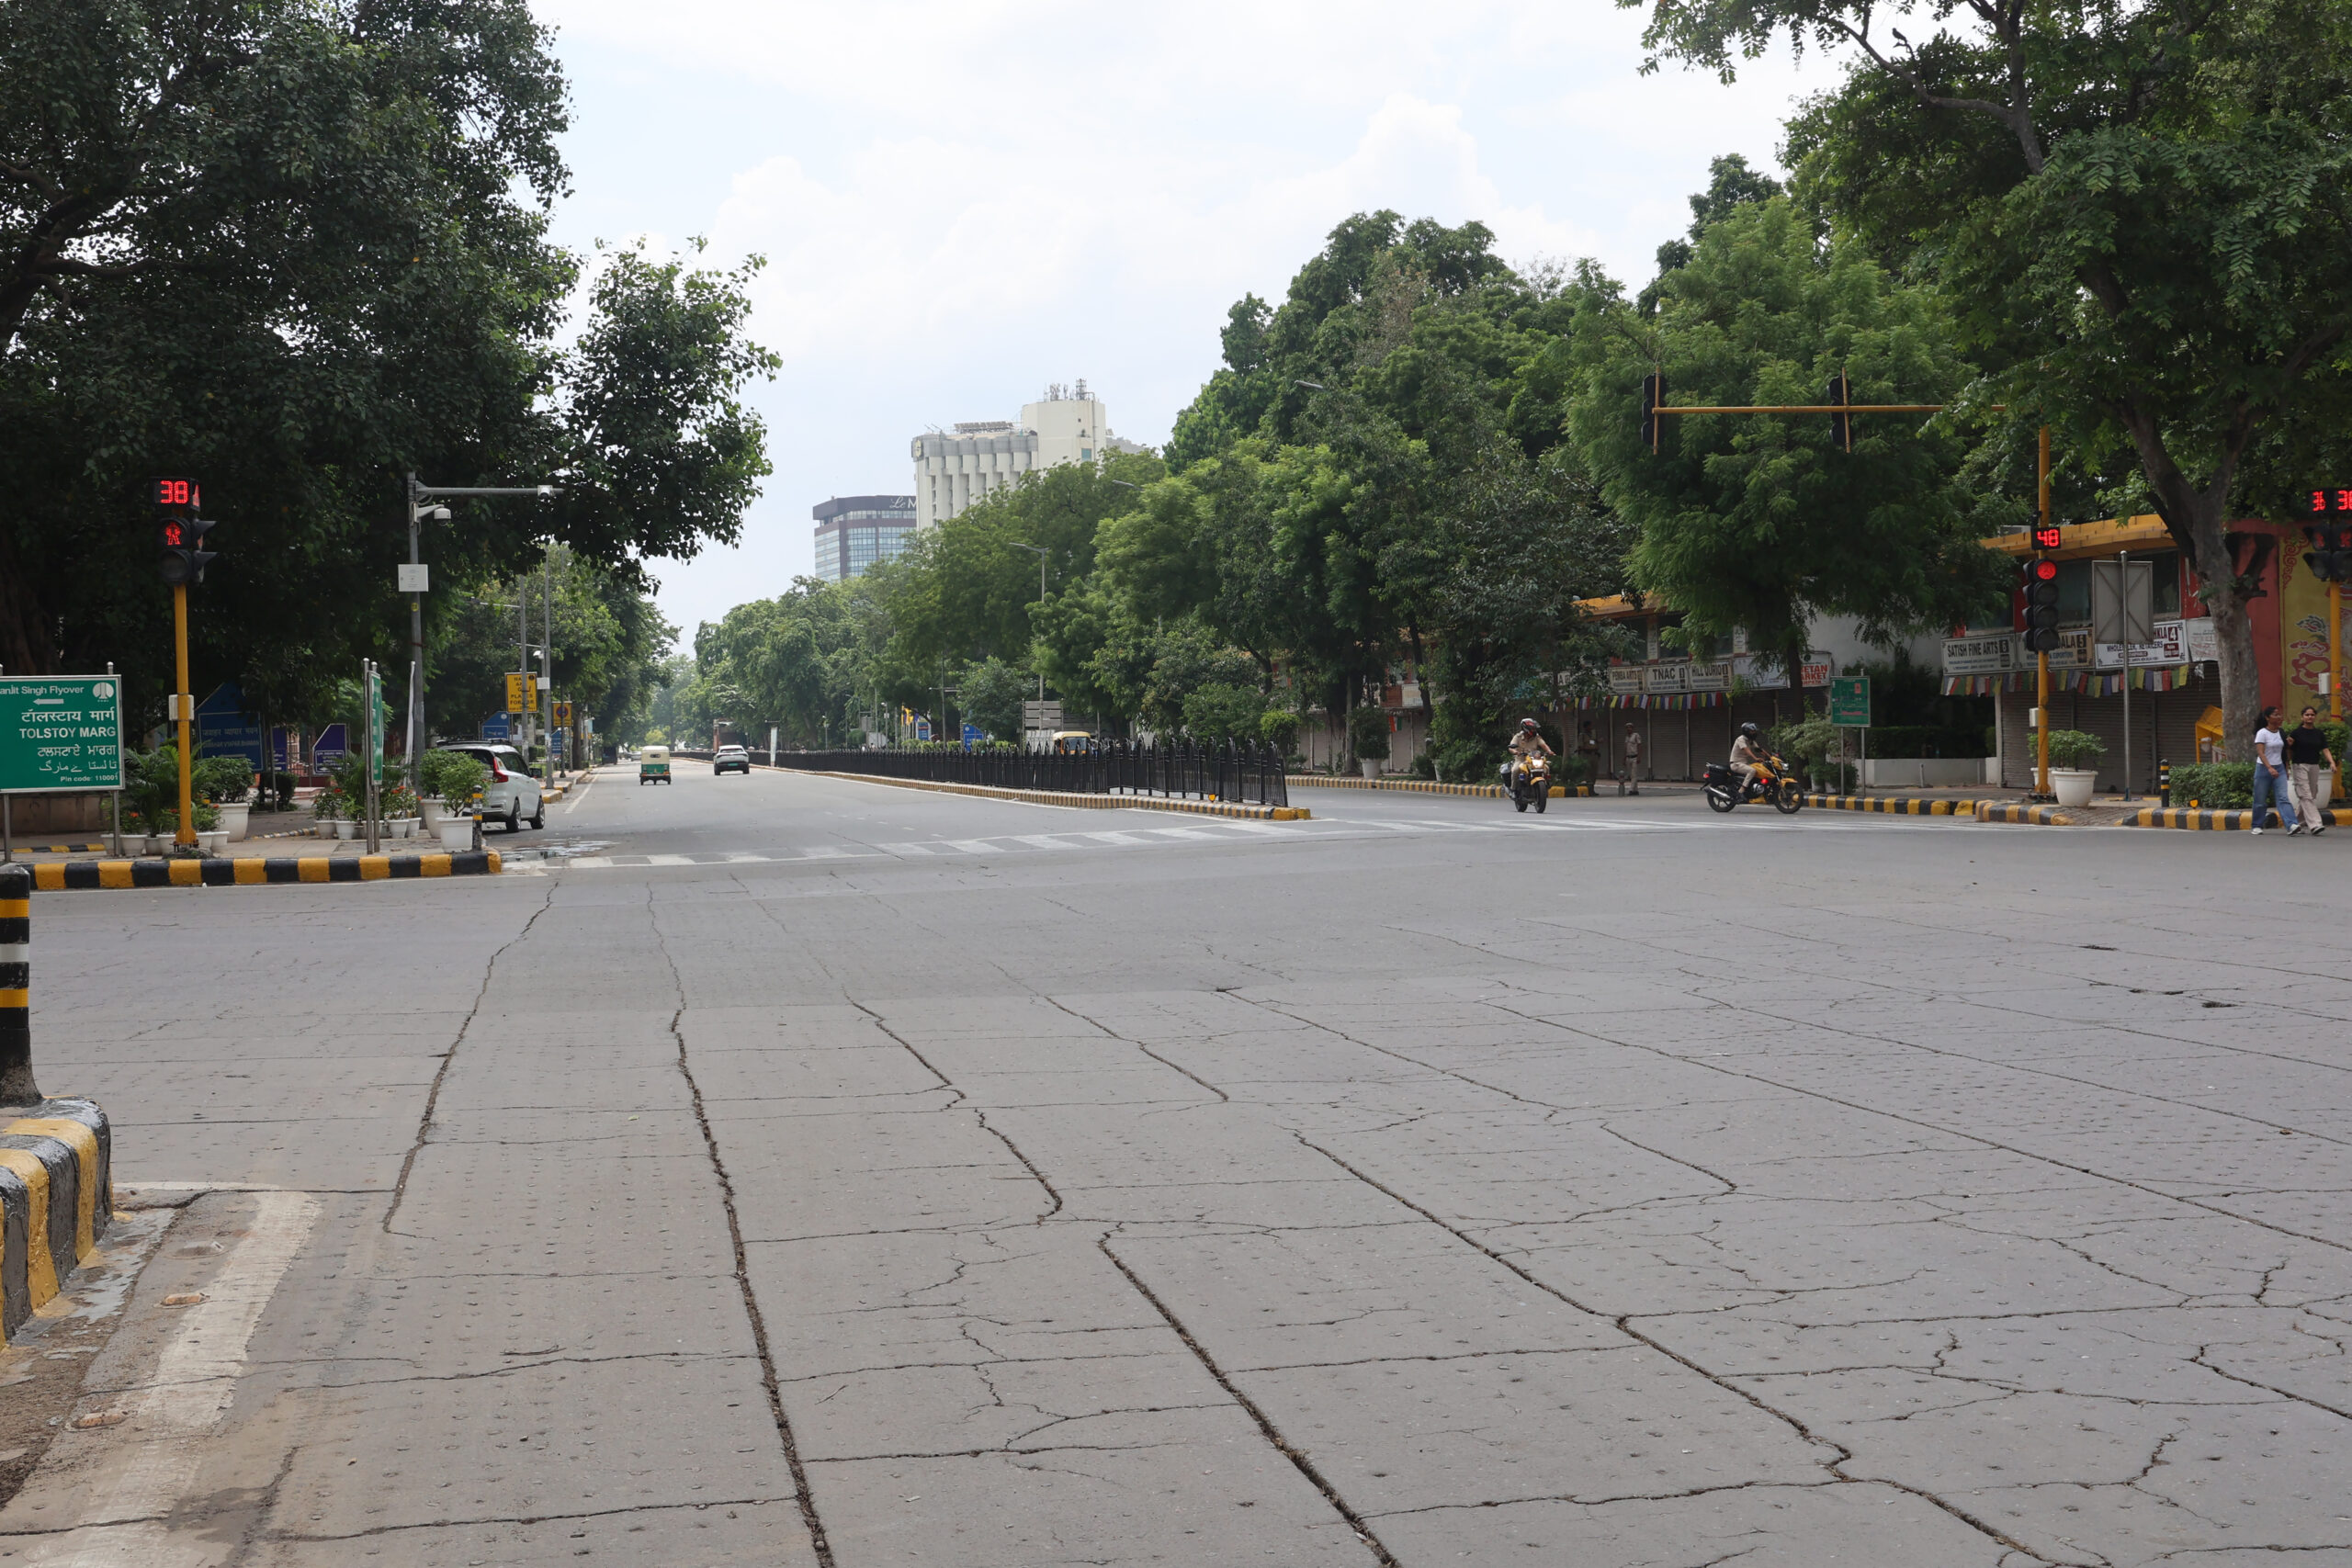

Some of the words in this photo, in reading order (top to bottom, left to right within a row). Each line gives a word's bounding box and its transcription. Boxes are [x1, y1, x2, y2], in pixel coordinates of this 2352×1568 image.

[160, 480, 188, 503] 38
[2037, 529, 2059, 547] 48
[1948, 644, 1967, 658] SATISH
[1968, 643, 1982, 656] FINE
[1984, 641, 1998, 655] ARTS
[1652, 668, 1676, 681] TNAC
[1801, 671, 1826, 681] ARKET
[21, 686, 47, 696] Singh
[50, 685, 85, 695] Flyover
[89, 706, 115, 721] मार्ग
[19, 728, 76, 739] TOLSTOY
[80, 727, 116, 738] MARG
[95, 773, 119, 781] 110001
